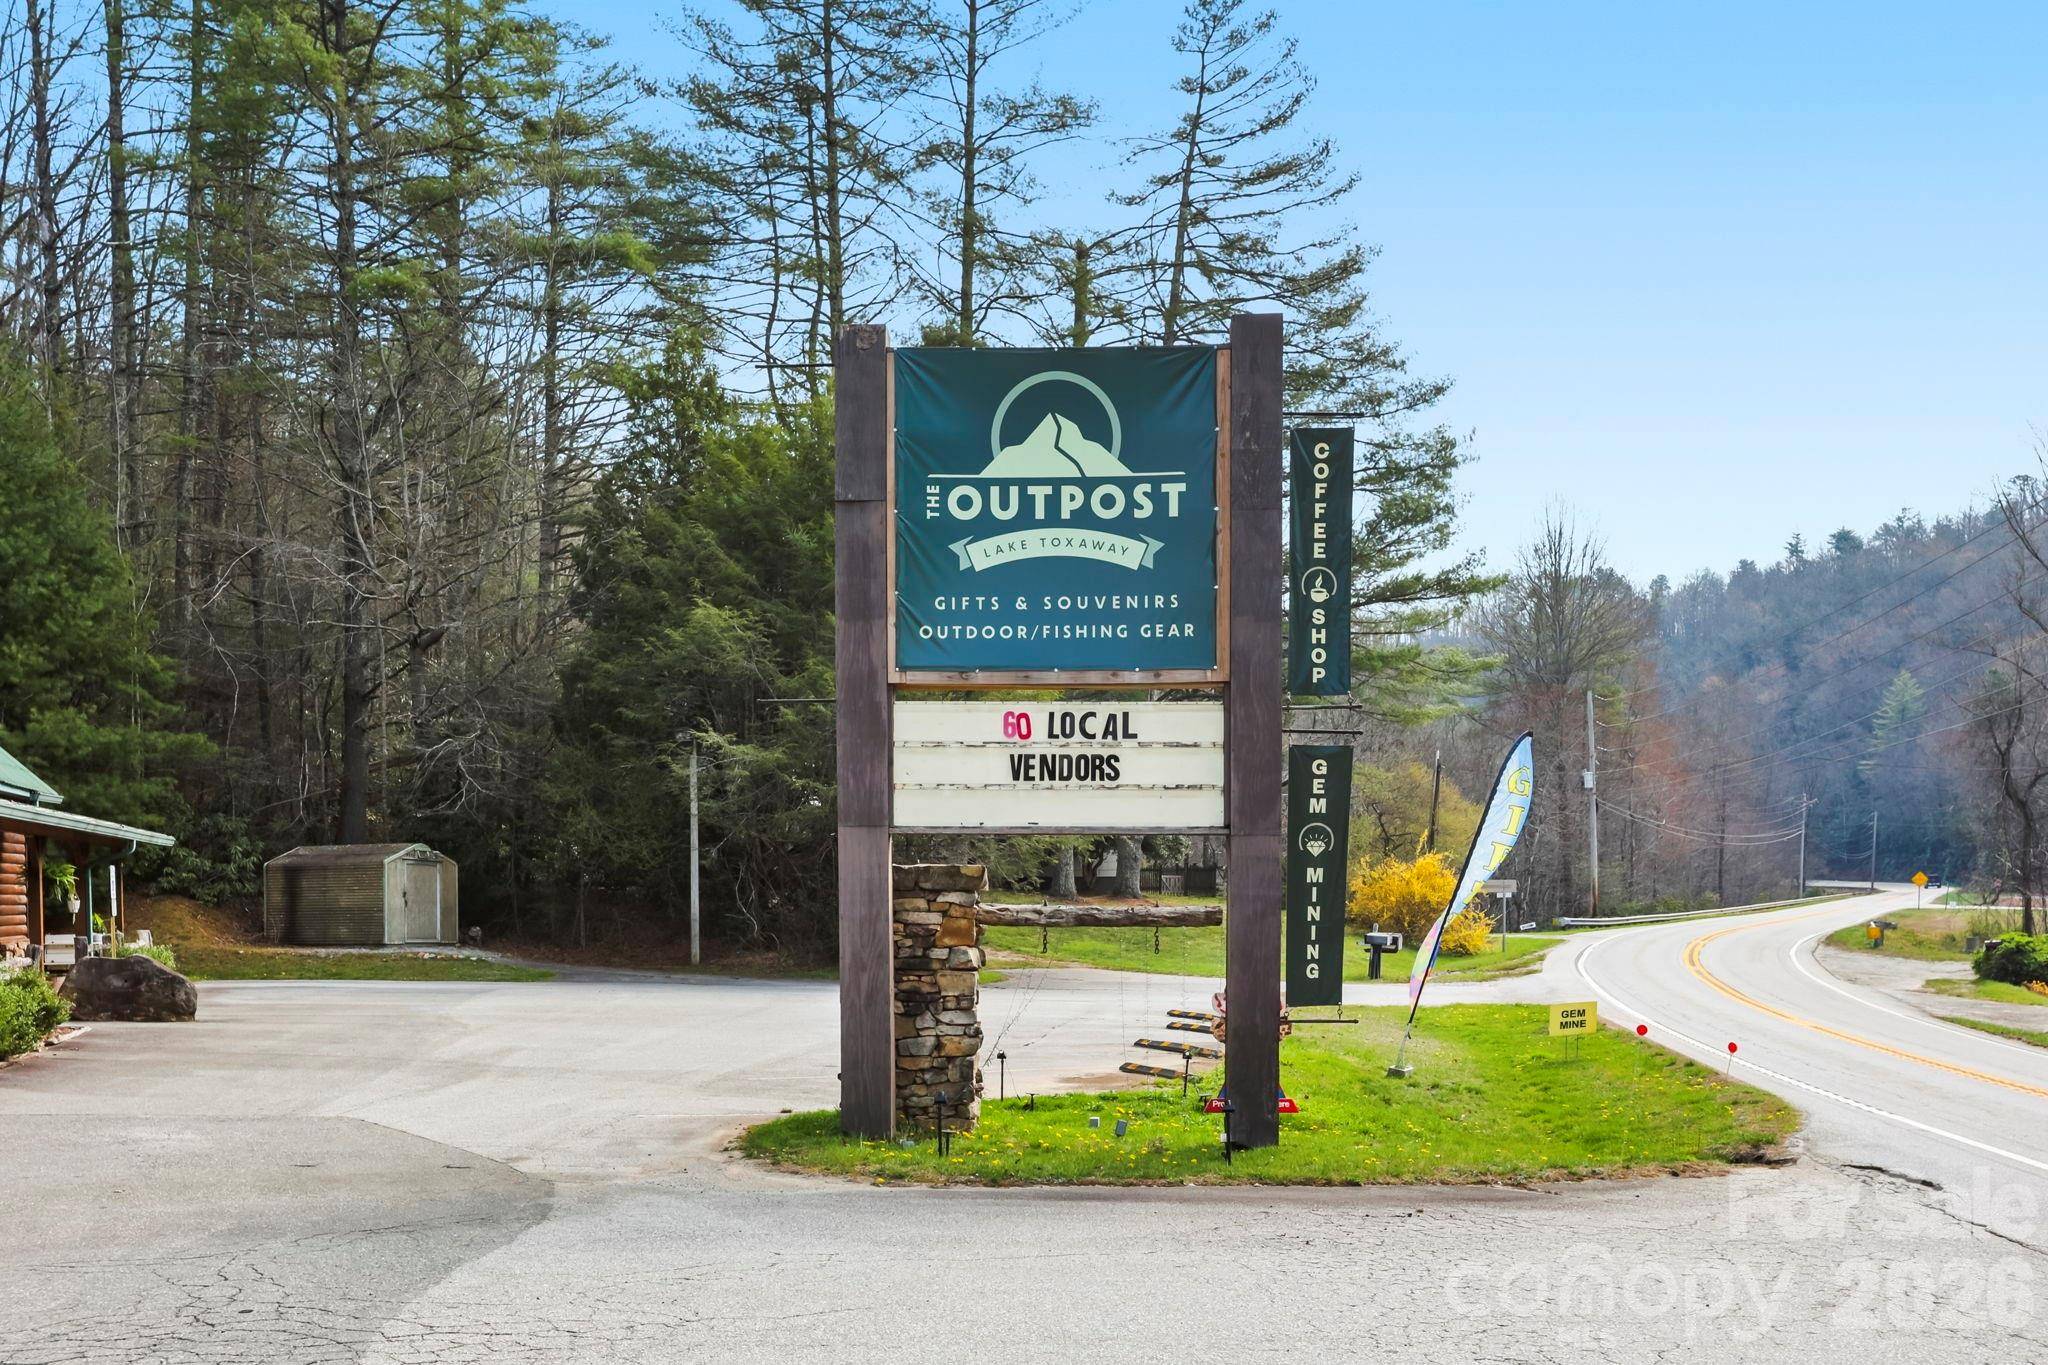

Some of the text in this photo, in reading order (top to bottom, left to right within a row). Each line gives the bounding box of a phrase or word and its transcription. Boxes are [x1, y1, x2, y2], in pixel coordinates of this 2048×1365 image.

[926, 482, 1187, 521] THE OUTPOST
[983, 536, 1130, 558] LAKE TOXAWAY
[1310, 442, 1330, 683] COFFEE SHOP
[934, 593, 1180, 611] GIFTS & SOUVENIRS
[918, 623, 1195, 641] OUTDOOR/FISHING GEAR
[1002, 710, 1138, 741] 60 LOCAL
[1009, 753, 1121, 782] VENDORS
[1305, 759, 1328, 979] GEM MINING
[1560, 1009, 1587, 1029] GEM MINE
